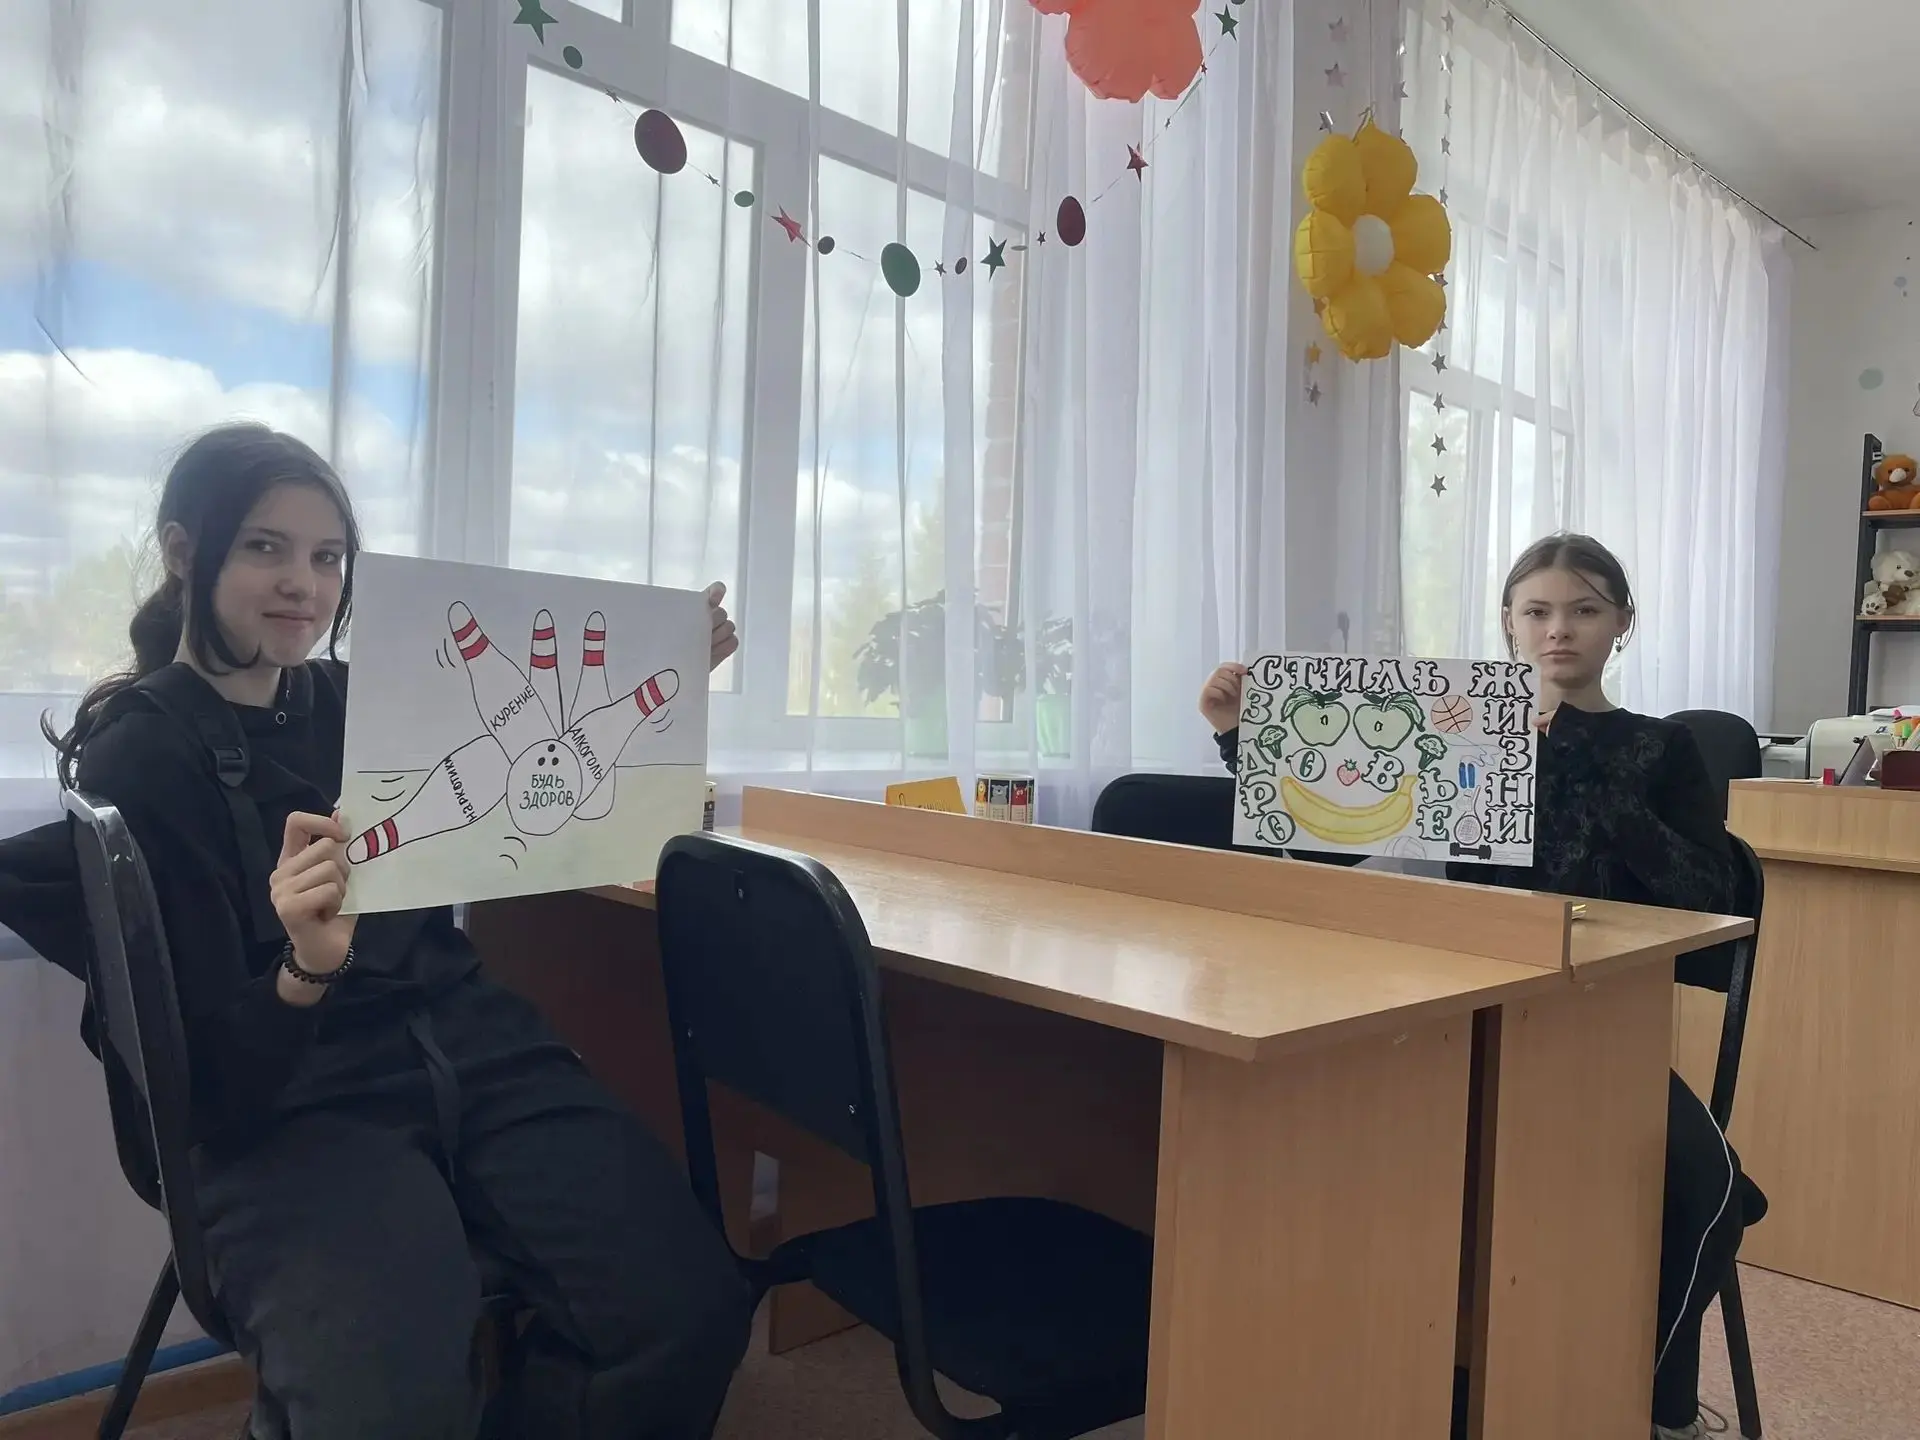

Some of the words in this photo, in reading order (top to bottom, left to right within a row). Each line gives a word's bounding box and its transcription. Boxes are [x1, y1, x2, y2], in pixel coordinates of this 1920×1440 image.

[490, 685, 535, 732] КУРЕНИЕ
[569, 728, 602, 780] АЛКОГОЛЬ
[1247, 655, 1450, 696] СТИЛЬ
[1467, 661, 1535, 844] ЖИЗНИ
[519, 790, 575, 810] ЗДОРОВ
[531, 774, 565, 789] БУДЬ
